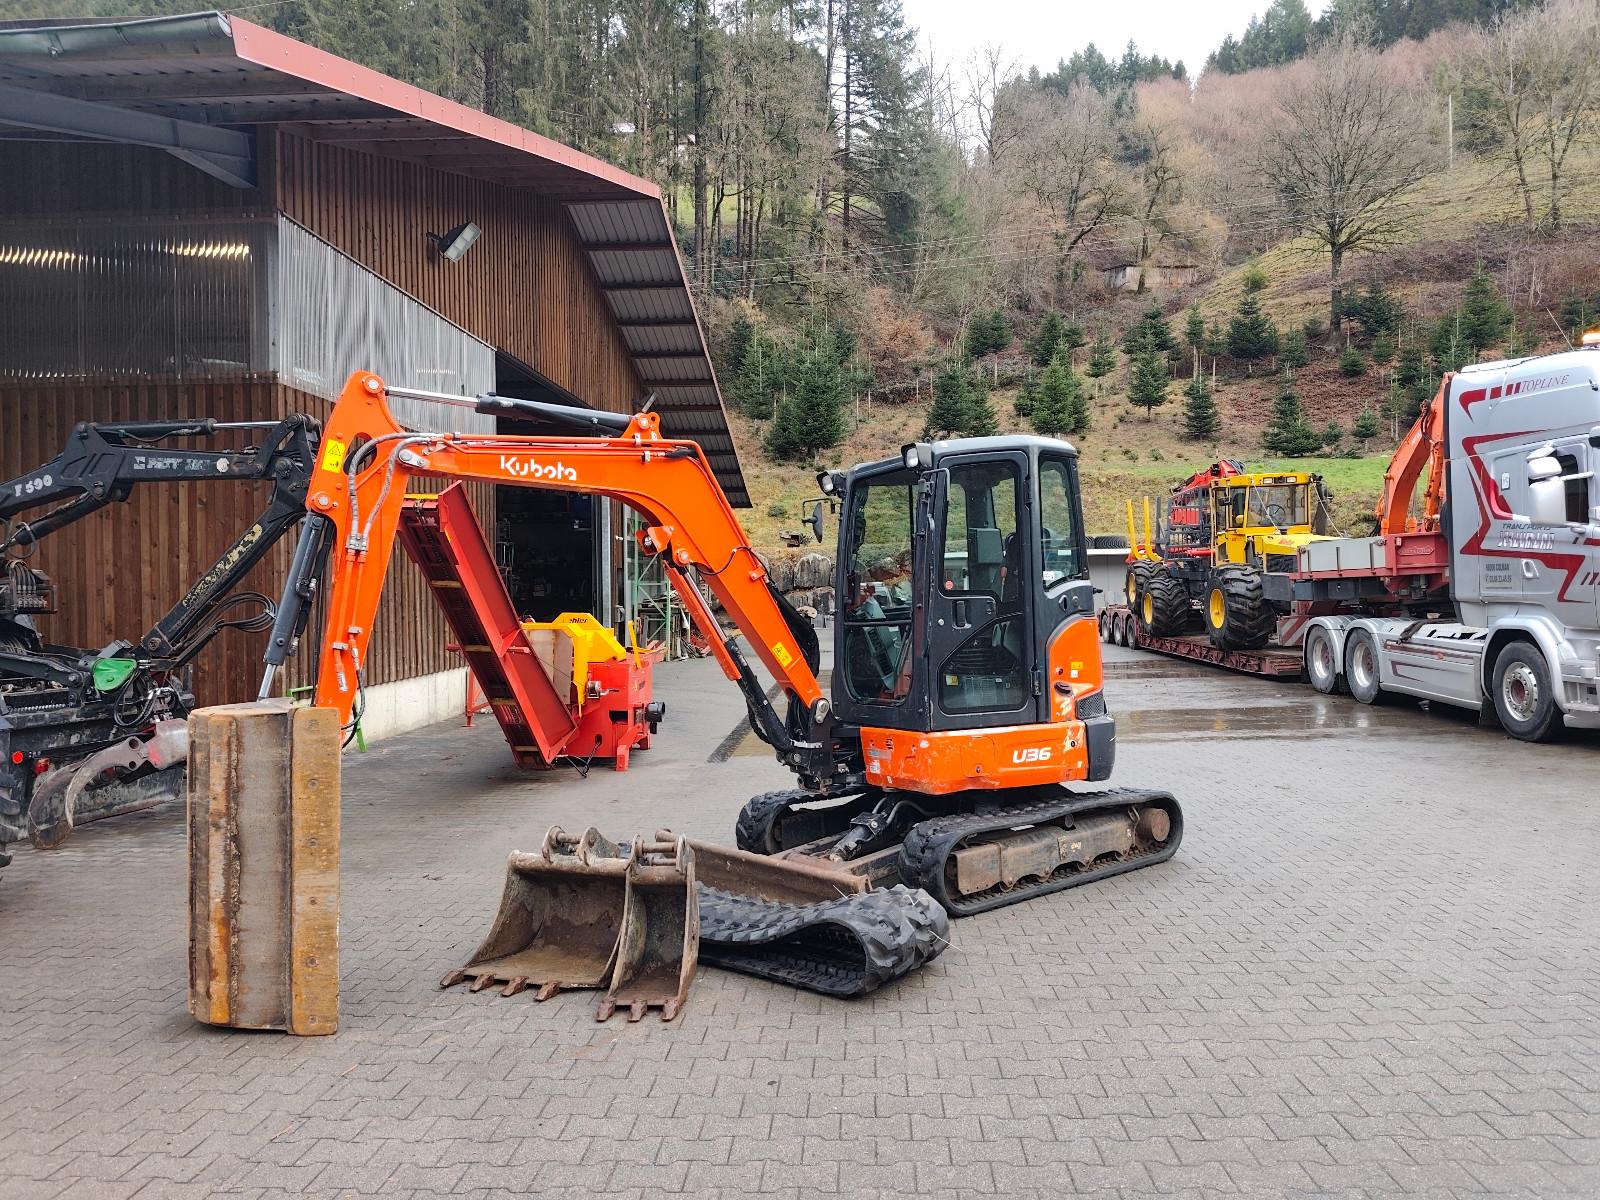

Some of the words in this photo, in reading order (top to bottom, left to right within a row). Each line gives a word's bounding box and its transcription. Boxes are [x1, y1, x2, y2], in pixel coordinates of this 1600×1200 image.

[1521, 374, 1570, 393] TOPLINE
[500, 455, 577, 481] Kubota
[1012, 746, 1052, 764] U36
